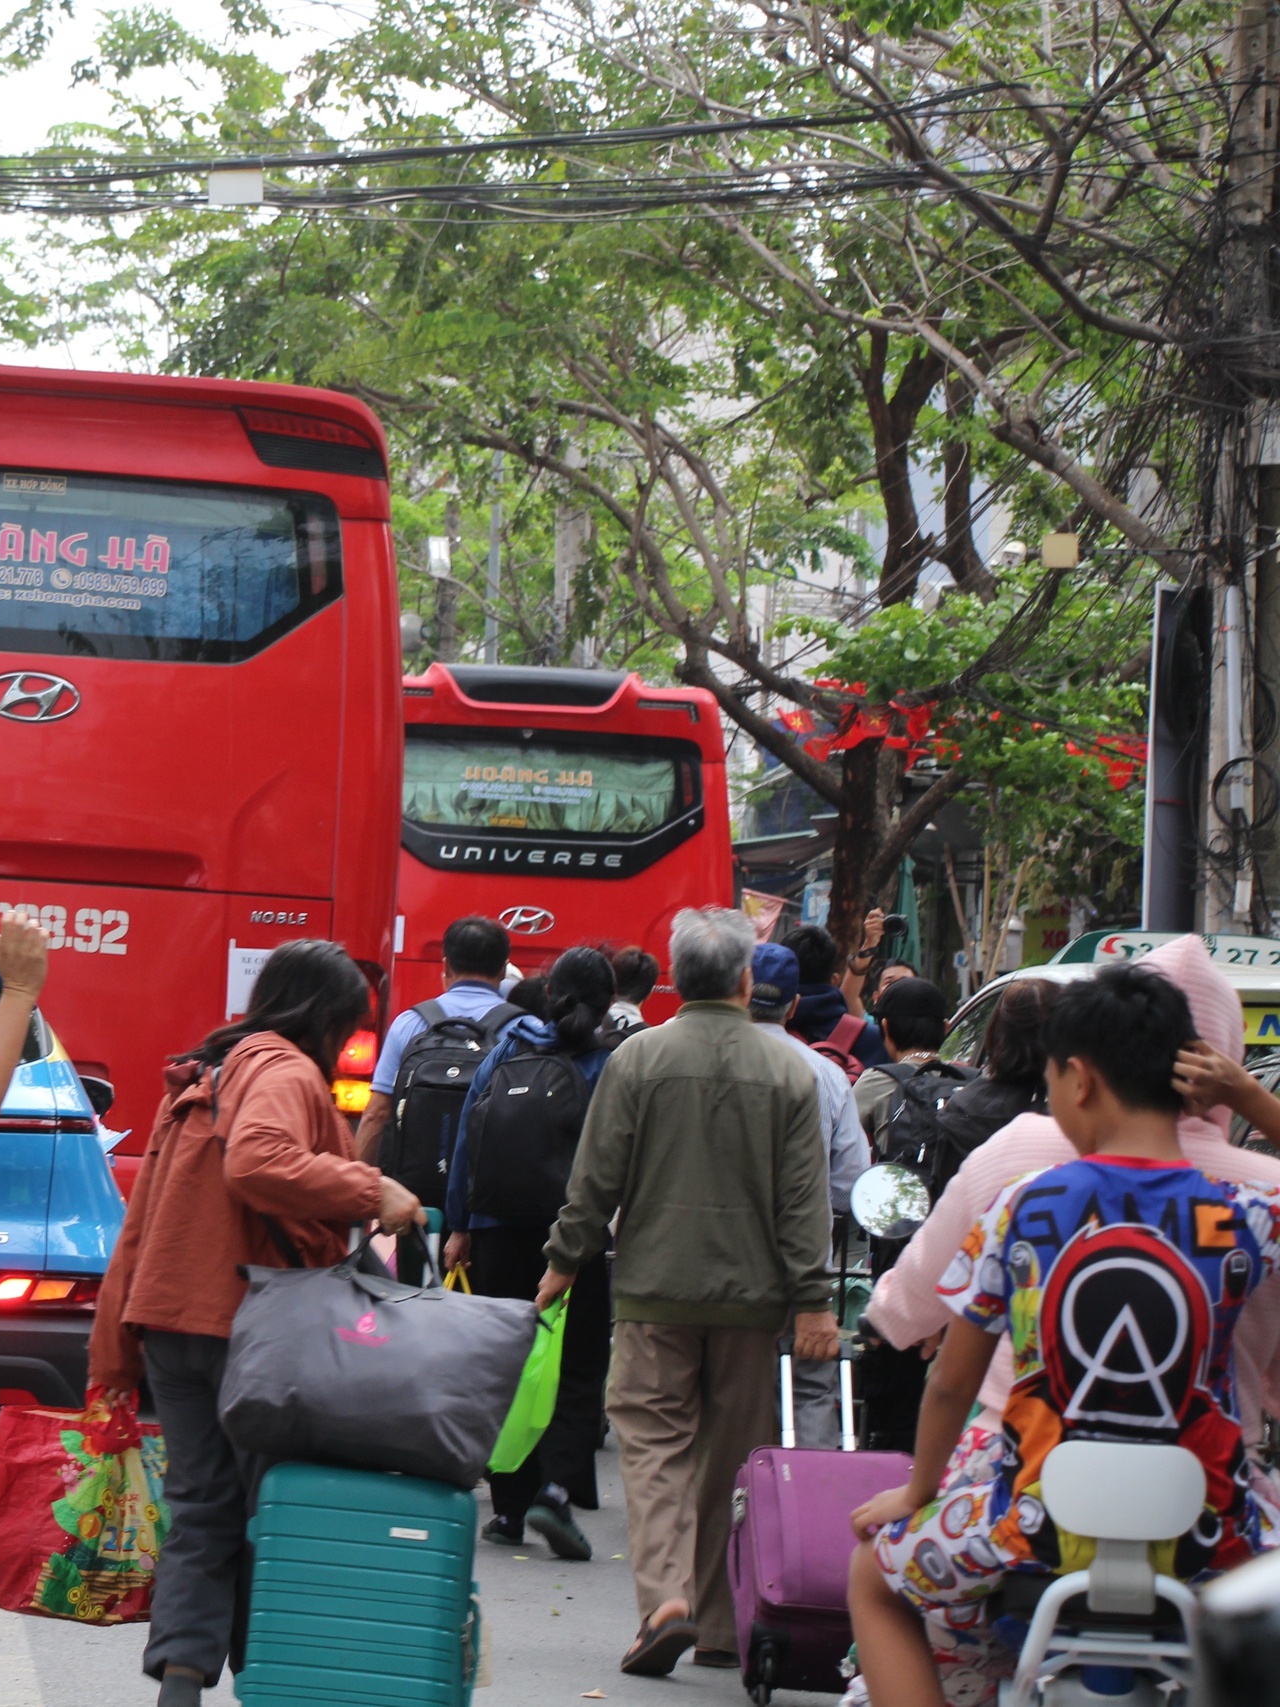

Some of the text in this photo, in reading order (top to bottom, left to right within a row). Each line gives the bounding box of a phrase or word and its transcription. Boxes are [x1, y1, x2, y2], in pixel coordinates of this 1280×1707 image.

[5, 478, 19, 489] XE
[14, 589, 142, 611] xehoangha.com
[439, 845, 623, 868] UNIVERSE
[249, 910, 309, 926] NOBLE
[1226, 947, 1260, 966] 27
